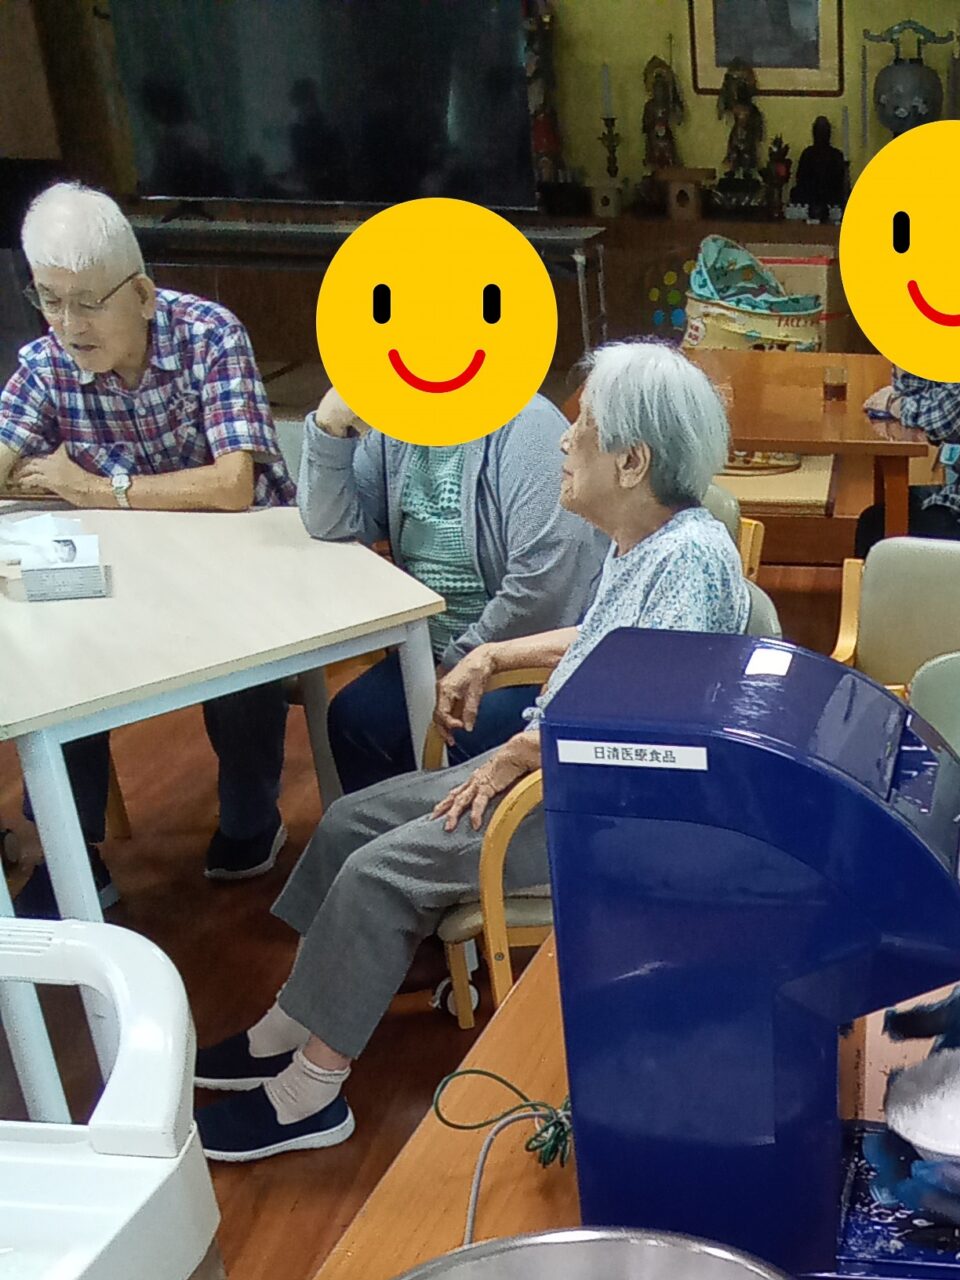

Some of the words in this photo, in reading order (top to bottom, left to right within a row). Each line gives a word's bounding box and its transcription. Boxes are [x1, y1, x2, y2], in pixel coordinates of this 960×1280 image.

[594, 746, 676, 763] 日清医療食品
